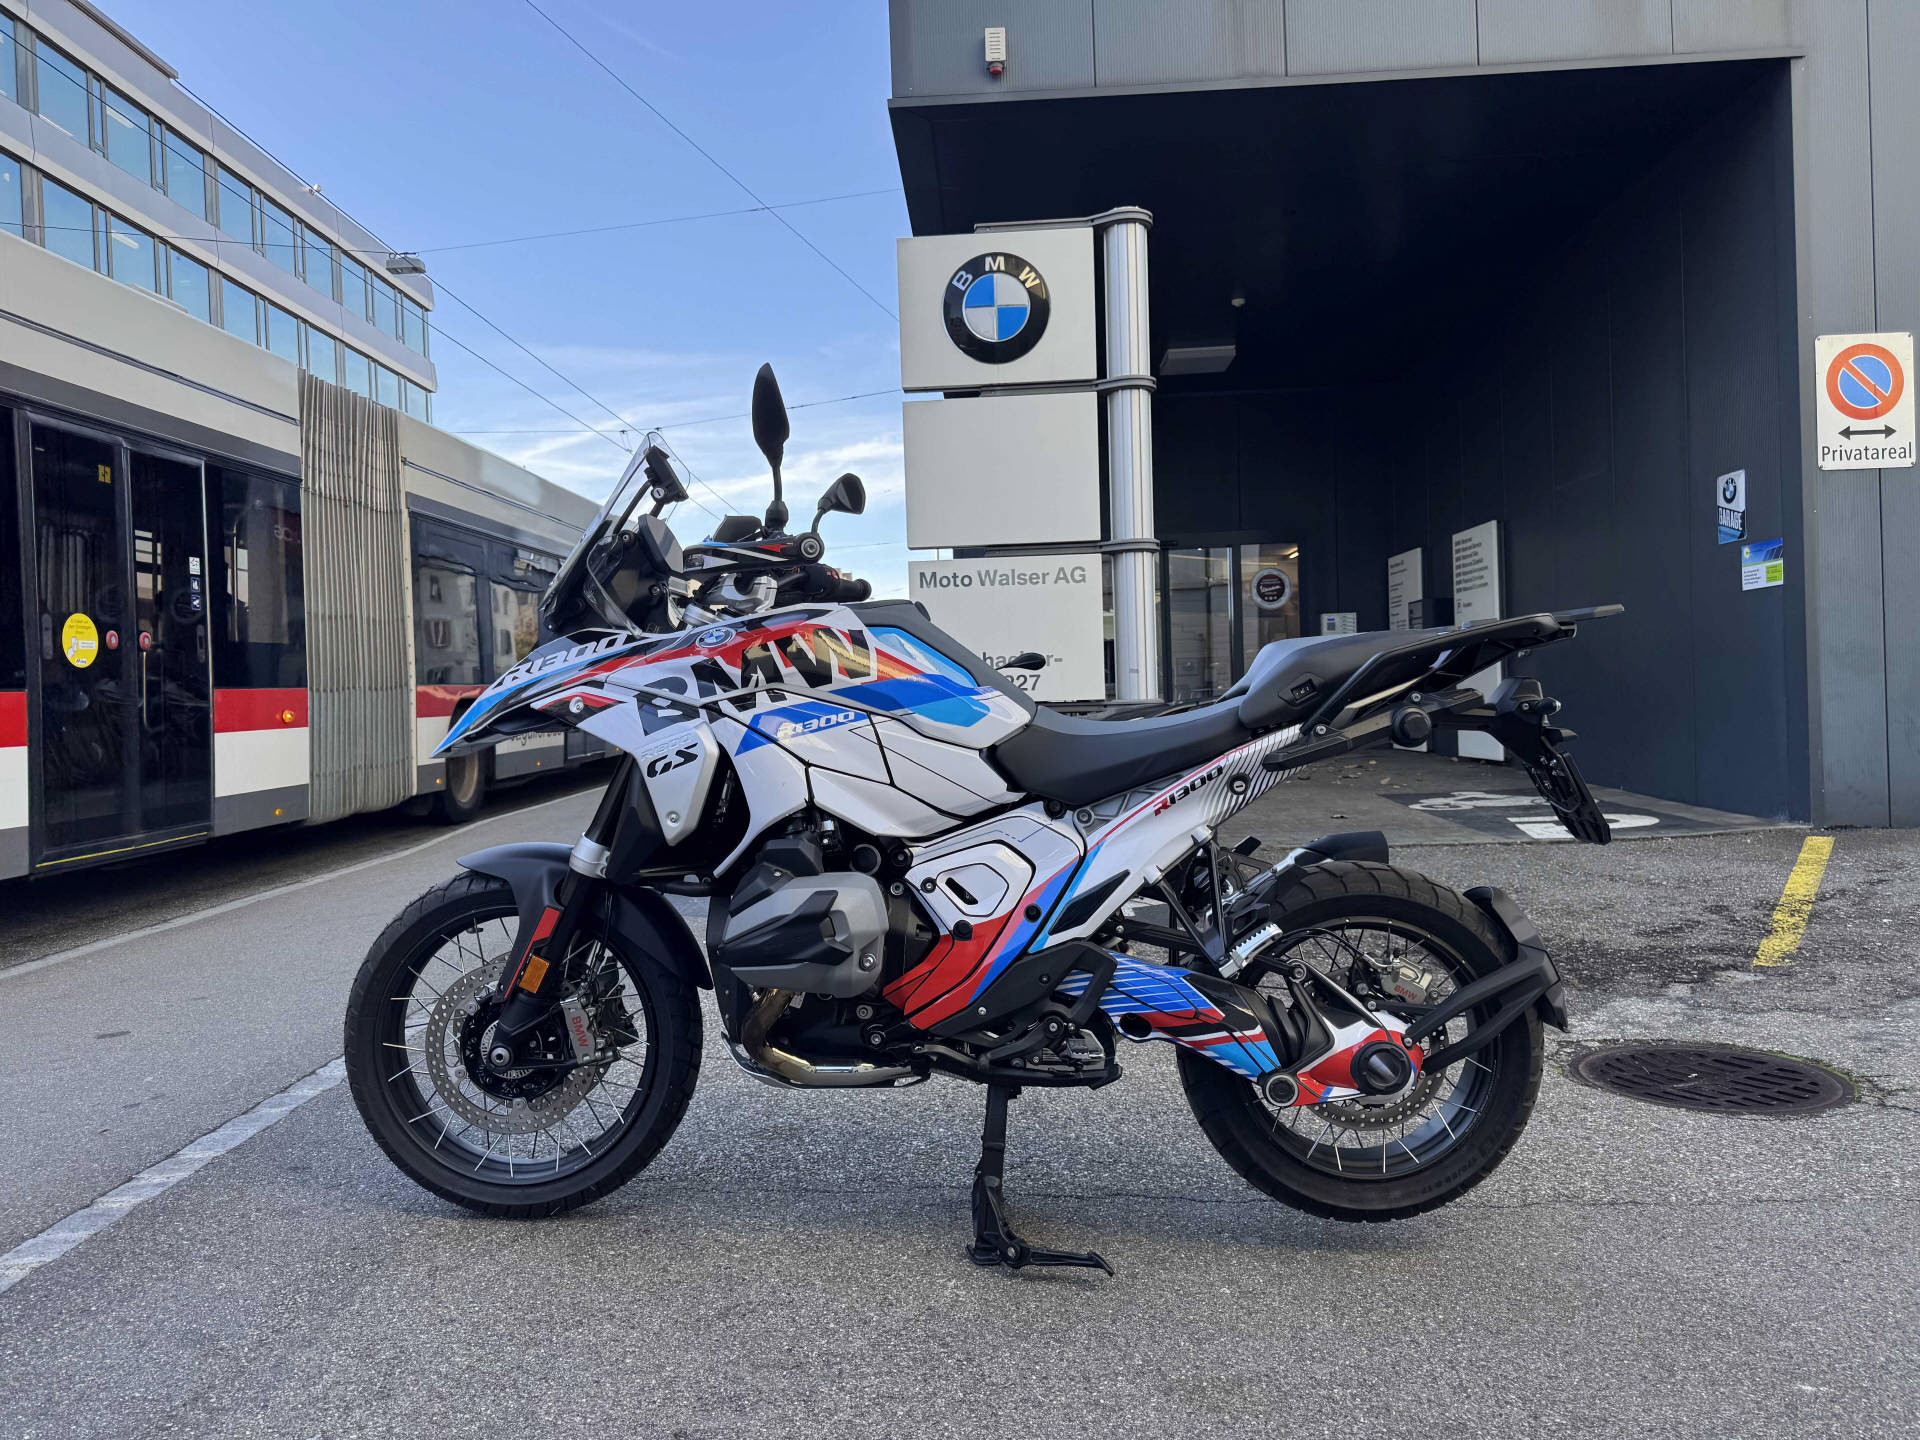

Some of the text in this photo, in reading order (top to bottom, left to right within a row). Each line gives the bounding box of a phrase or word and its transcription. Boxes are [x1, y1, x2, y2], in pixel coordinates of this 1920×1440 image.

[952, 255, 1040, 291] BMW
[1821, 442, 1912, 462] Privatareal
[1718, 507, 1743, 530] GARAGE
[919, 566, 1087, 589] Moto Walser AG
[634, 628, 871, 736] BMW
[647, 743, 698, 778] GS
[1394, 984, 1417, 1000] BMW
[572, 1016, 589, 1047] BMW
